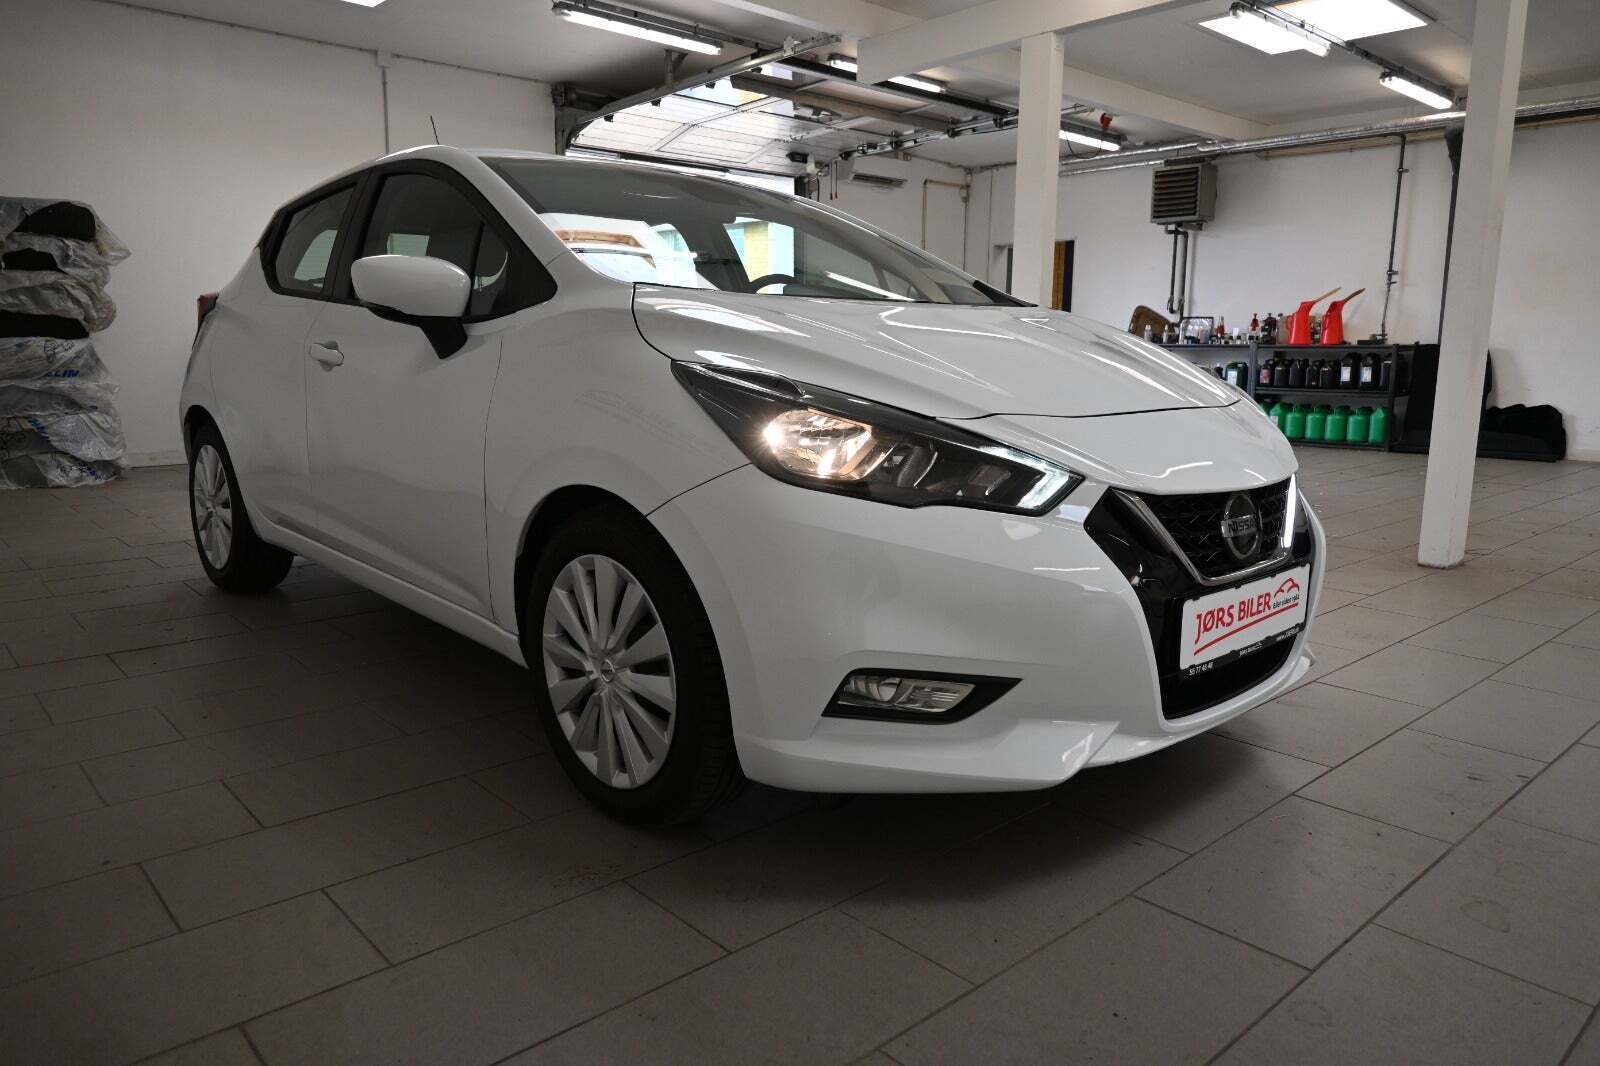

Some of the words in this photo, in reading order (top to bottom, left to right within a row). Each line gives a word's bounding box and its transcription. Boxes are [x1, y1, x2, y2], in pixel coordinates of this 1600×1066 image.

[1228, 516, 1257, 531] NISSA
[1195, 604, 1234, 644] JØRS
[1238, 592, 1271, 620] BILER
